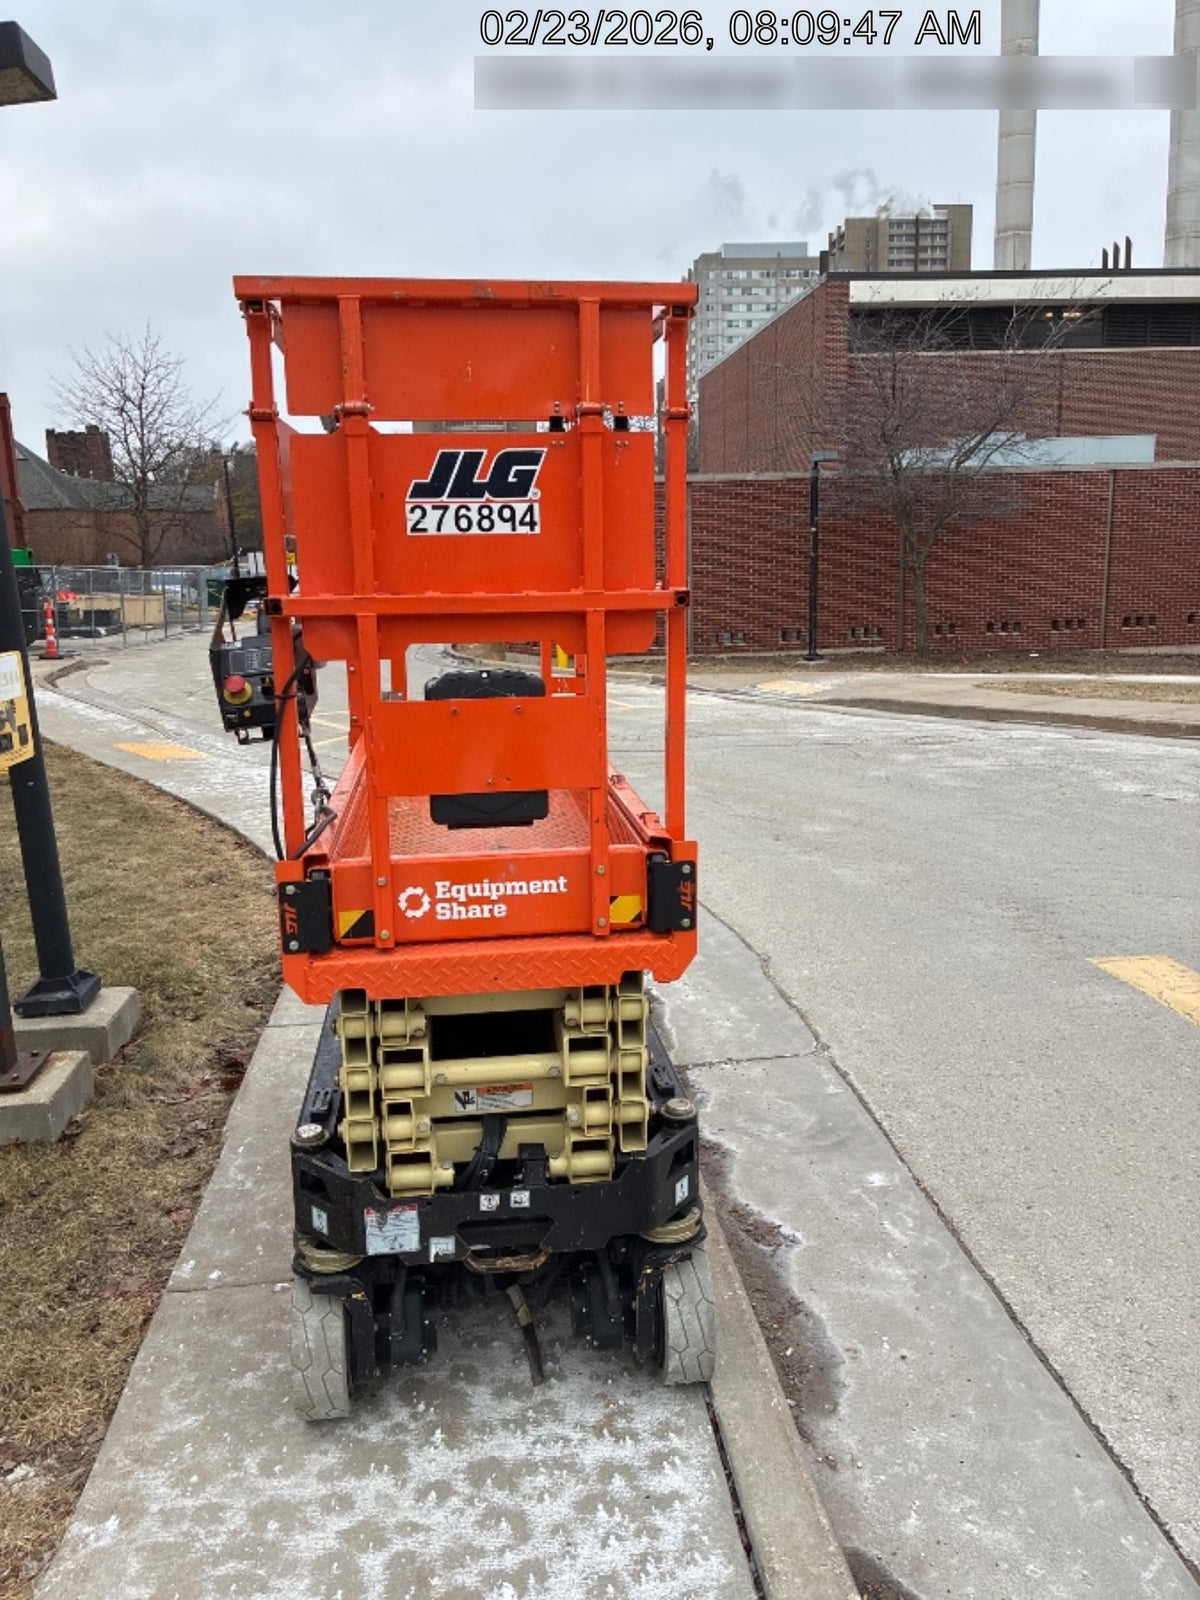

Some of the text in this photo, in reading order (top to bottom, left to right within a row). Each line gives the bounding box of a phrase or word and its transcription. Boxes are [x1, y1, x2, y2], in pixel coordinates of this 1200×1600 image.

[406, 447, 547, 502] JLG
[409, 504, 537, 534] 276894
[435, 875, 568, 902] Equipment
[284, 903, 298, 935] JLG
[435, 902, 507, 920] Share
